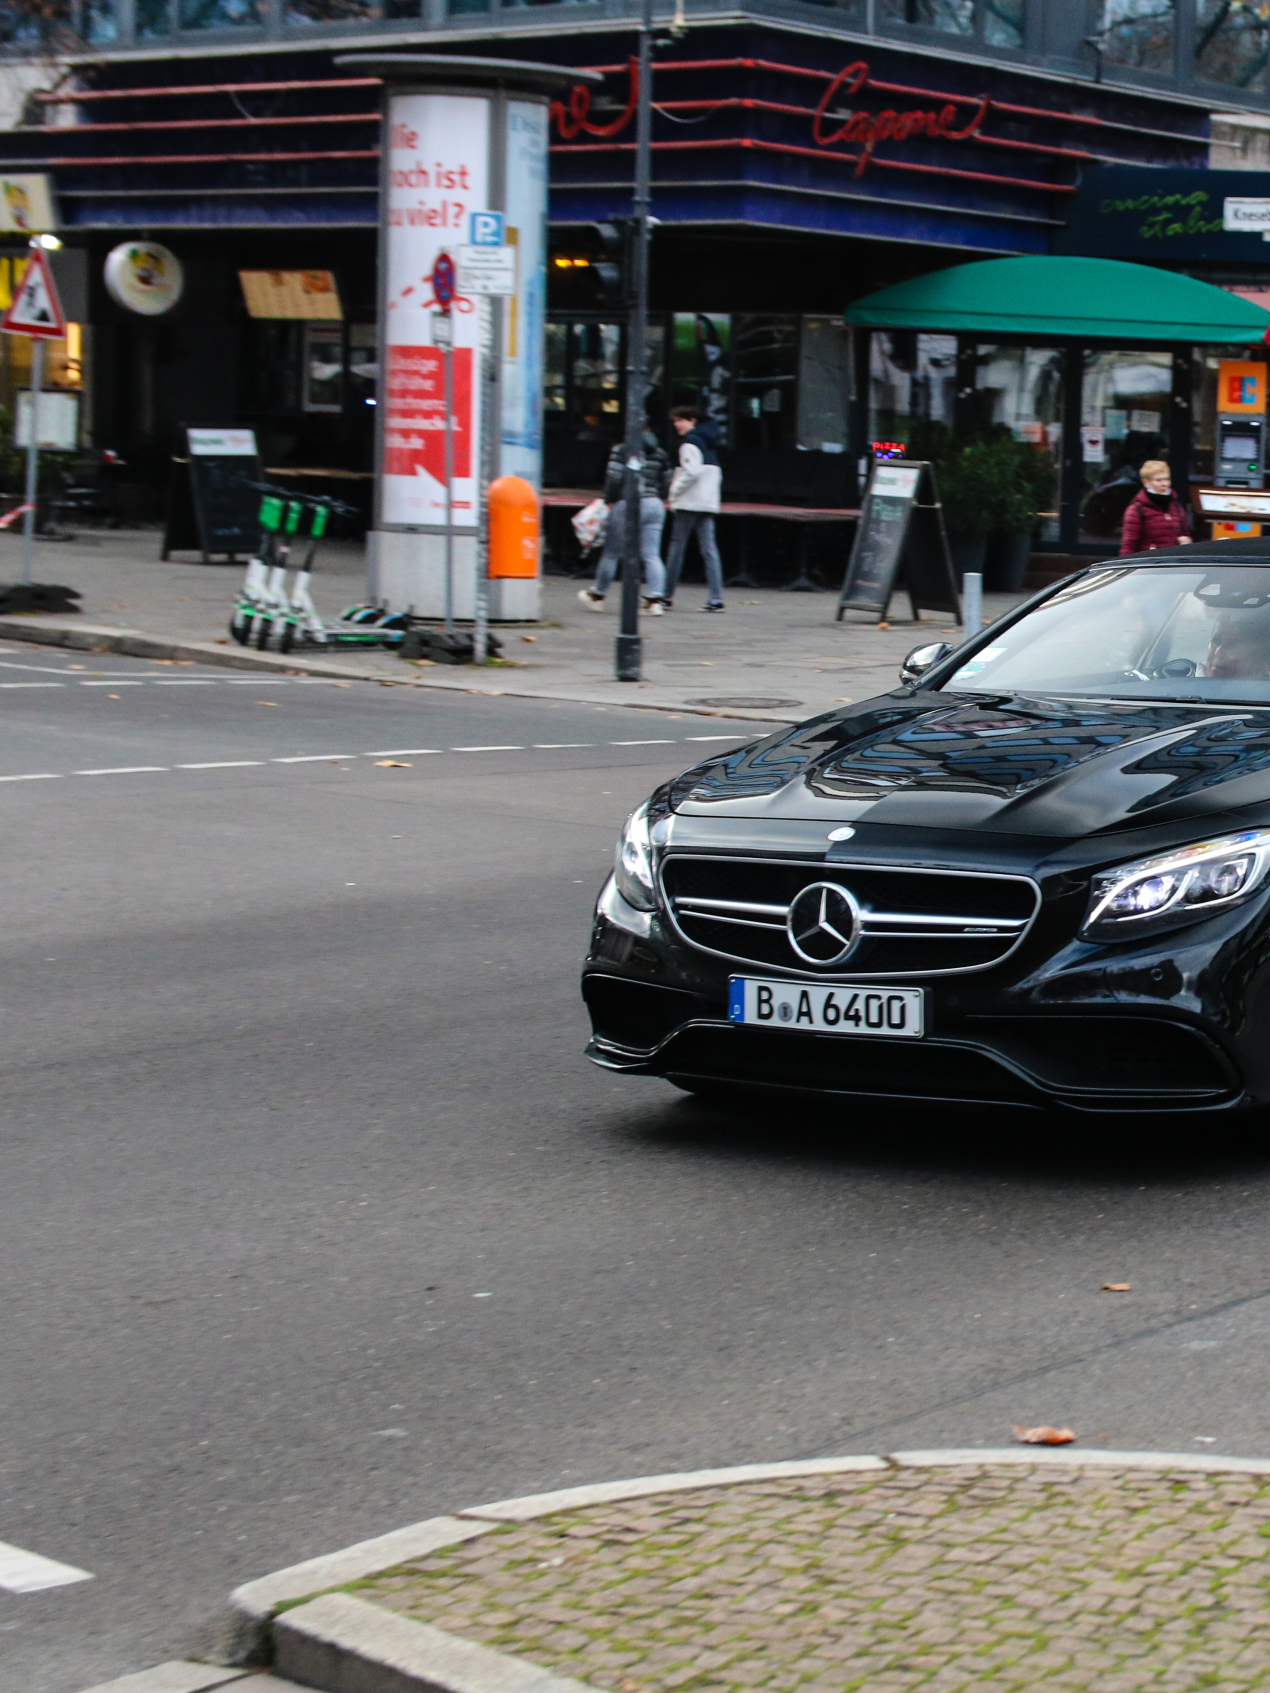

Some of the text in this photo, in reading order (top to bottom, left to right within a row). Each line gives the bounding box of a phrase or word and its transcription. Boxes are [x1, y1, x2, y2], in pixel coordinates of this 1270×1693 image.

[812, 61, 991, 179] Capone
[435, 162, 471, 190] ist
[475, 215, 498, 244] P
[1228, 376, 1258, 404] EC
[757, 985, 907, 1030] B A 6400
